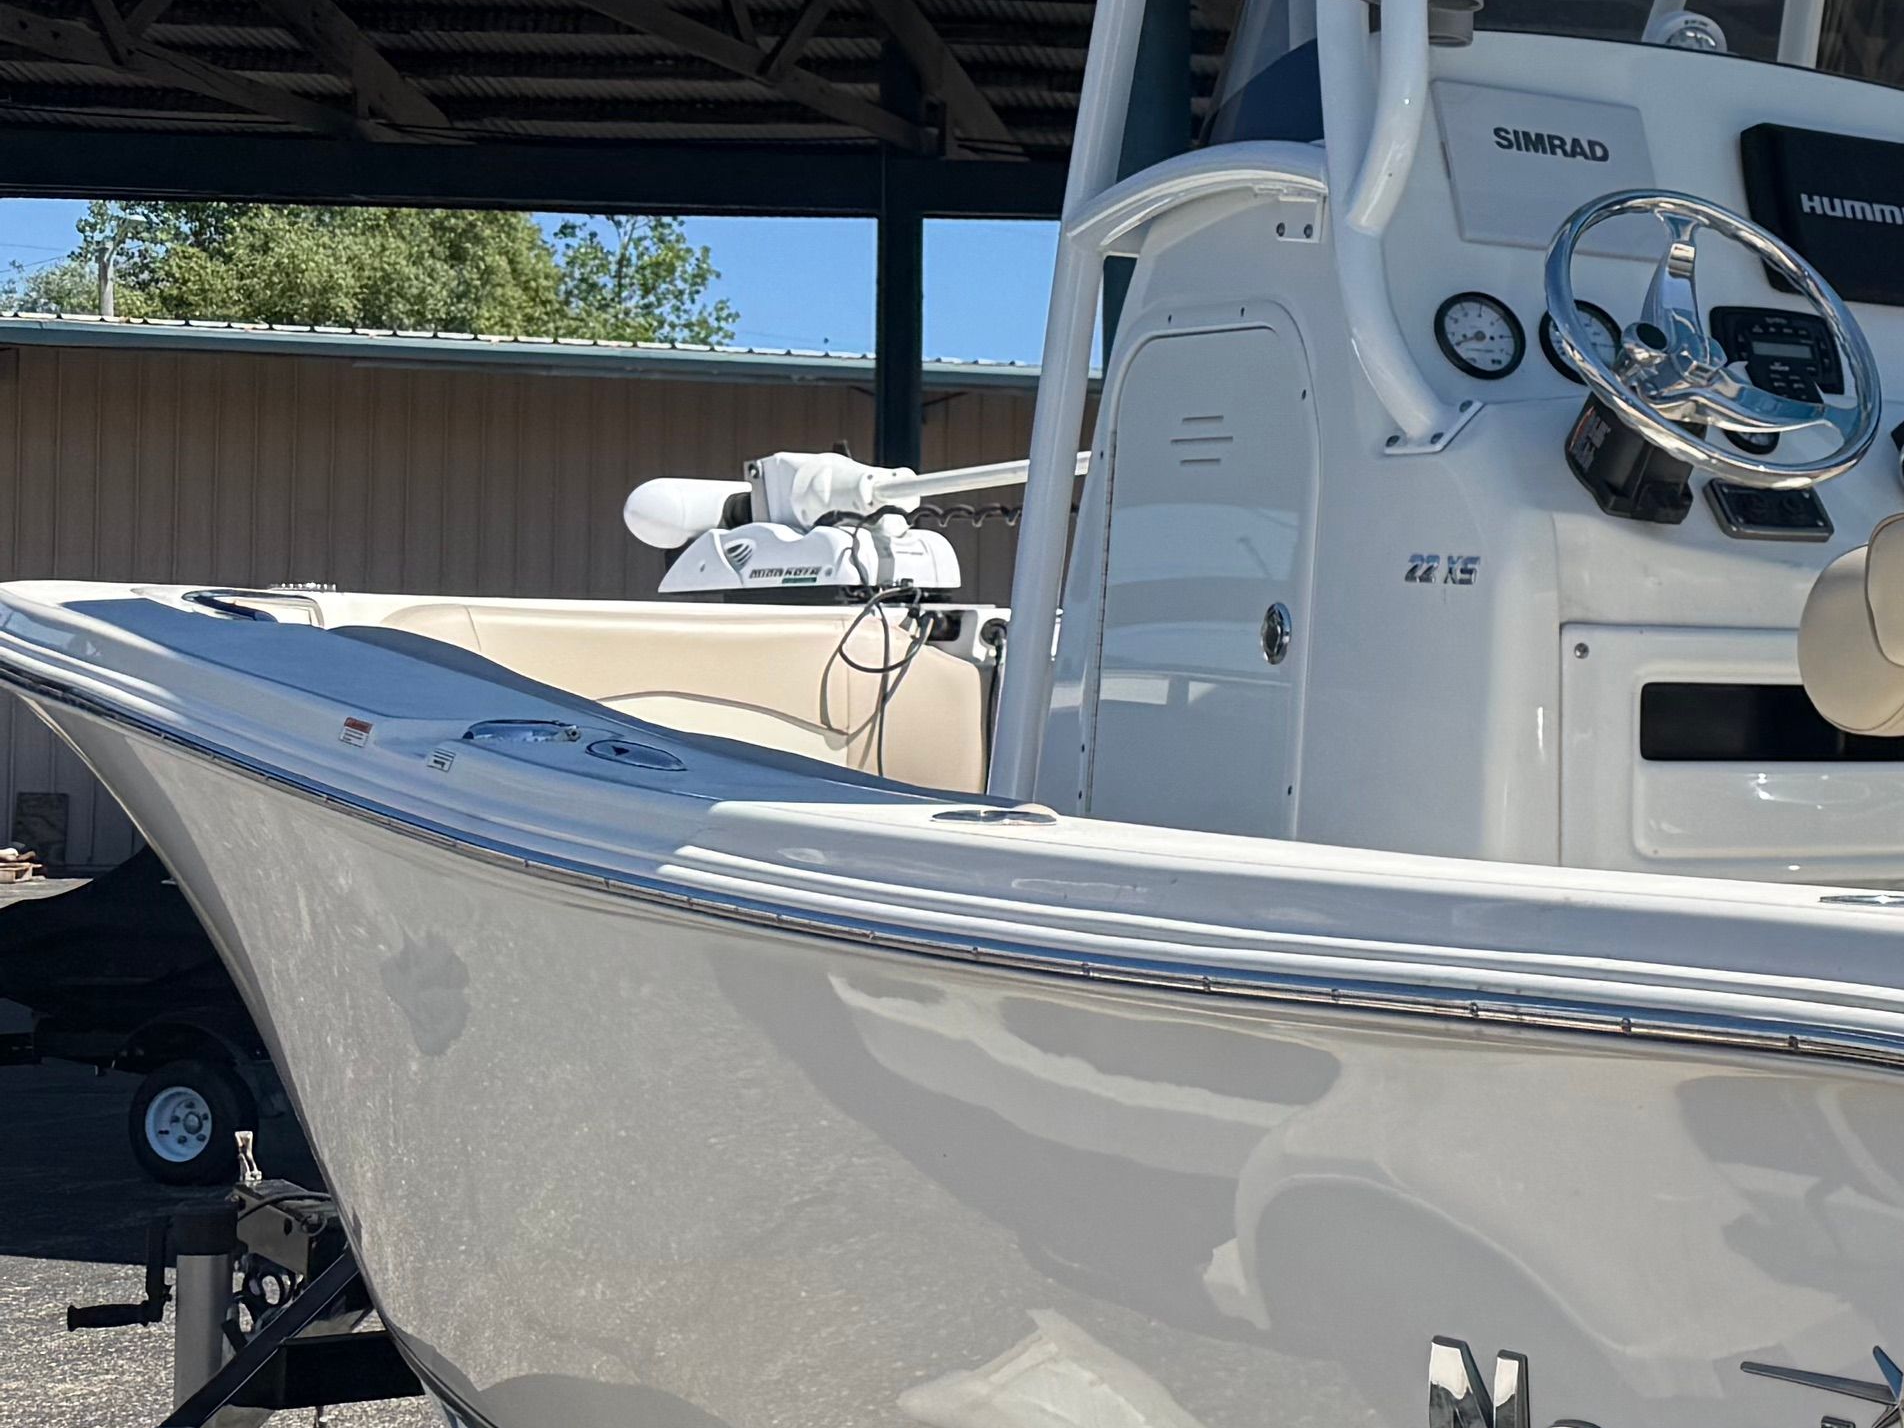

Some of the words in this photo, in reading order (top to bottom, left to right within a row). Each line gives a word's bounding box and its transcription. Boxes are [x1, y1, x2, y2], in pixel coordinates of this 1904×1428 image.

[1493, 126, 1610, 163] SIMRAD
[1404, 553, 1440, 584] 22
[1443, 554, 1481, 585] XS
